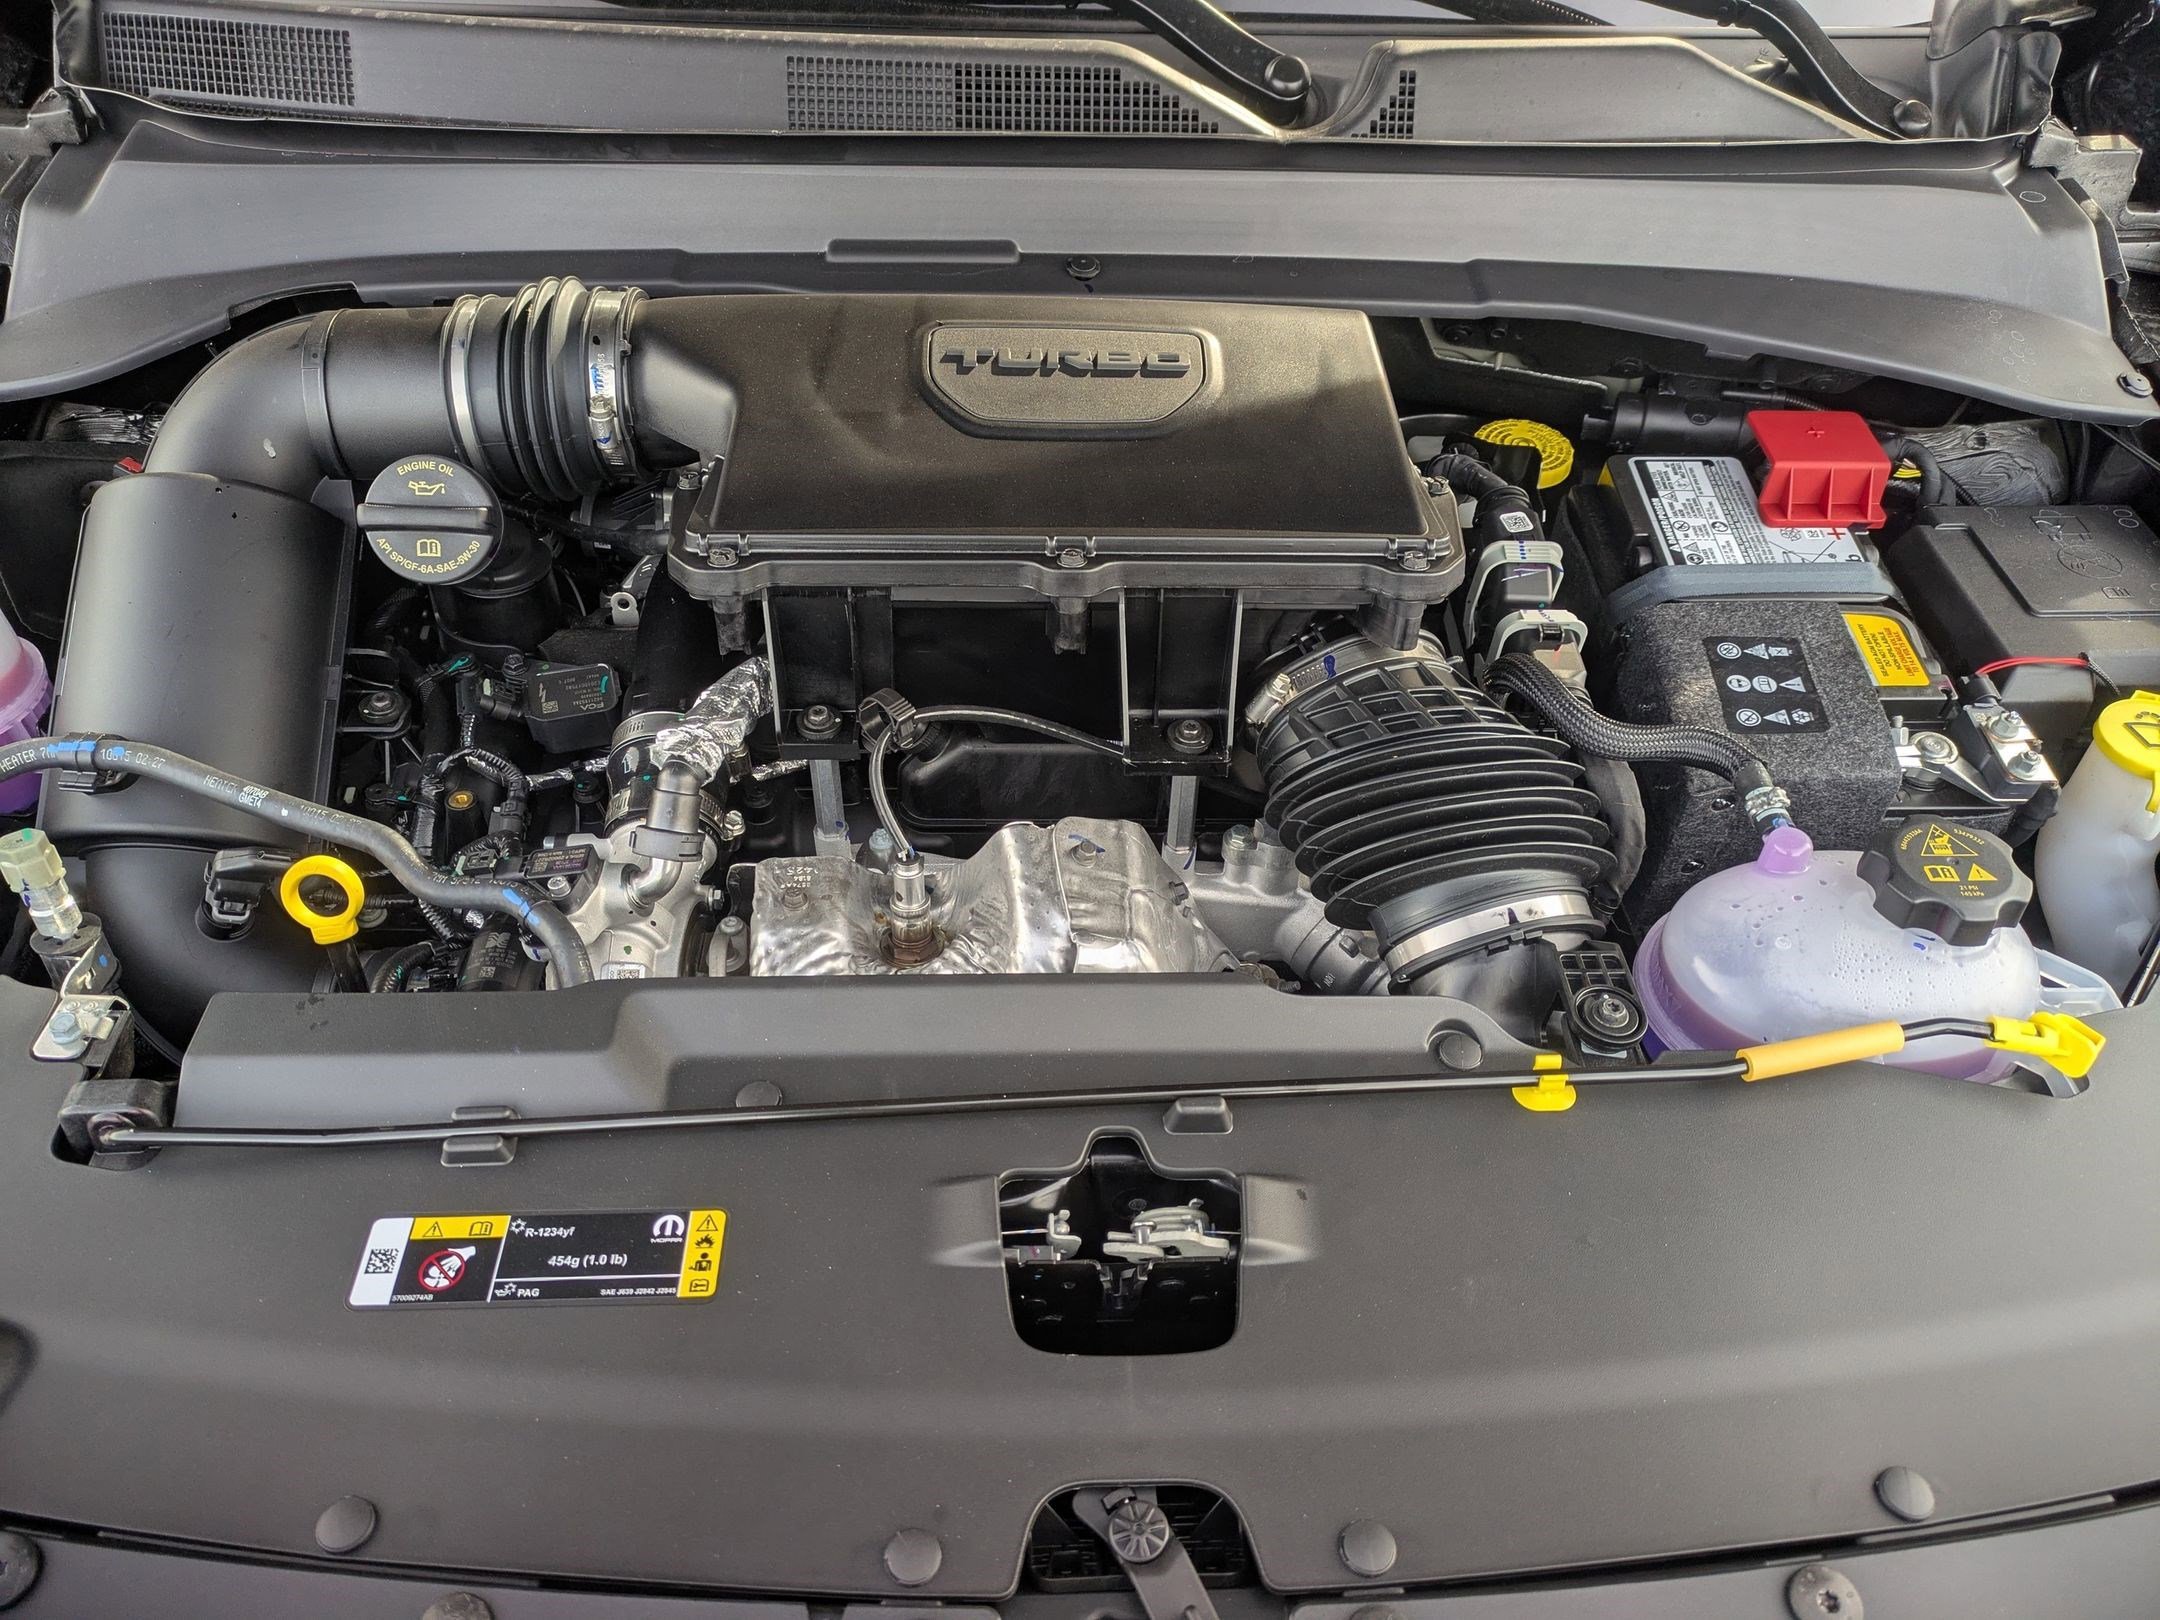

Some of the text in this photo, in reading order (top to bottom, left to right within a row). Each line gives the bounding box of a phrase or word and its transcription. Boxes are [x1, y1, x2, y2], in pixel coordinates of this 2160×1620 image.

[943, 347, 1191, 375] TURBO
[397, 461, 454, 476] ENGINE OIL
[377, 538, 391, 554] API
[580, 702, 604, 710] FCA
[0, 748, 38, 772] HEATER
[238, 792, 262, 808] GMET4
[525, 1226, 576, 1239] R-1234yf
[548, 1253, 628, 1268] 454g (1.0 lb)
[517, 1288, 540, 1298] PAG
